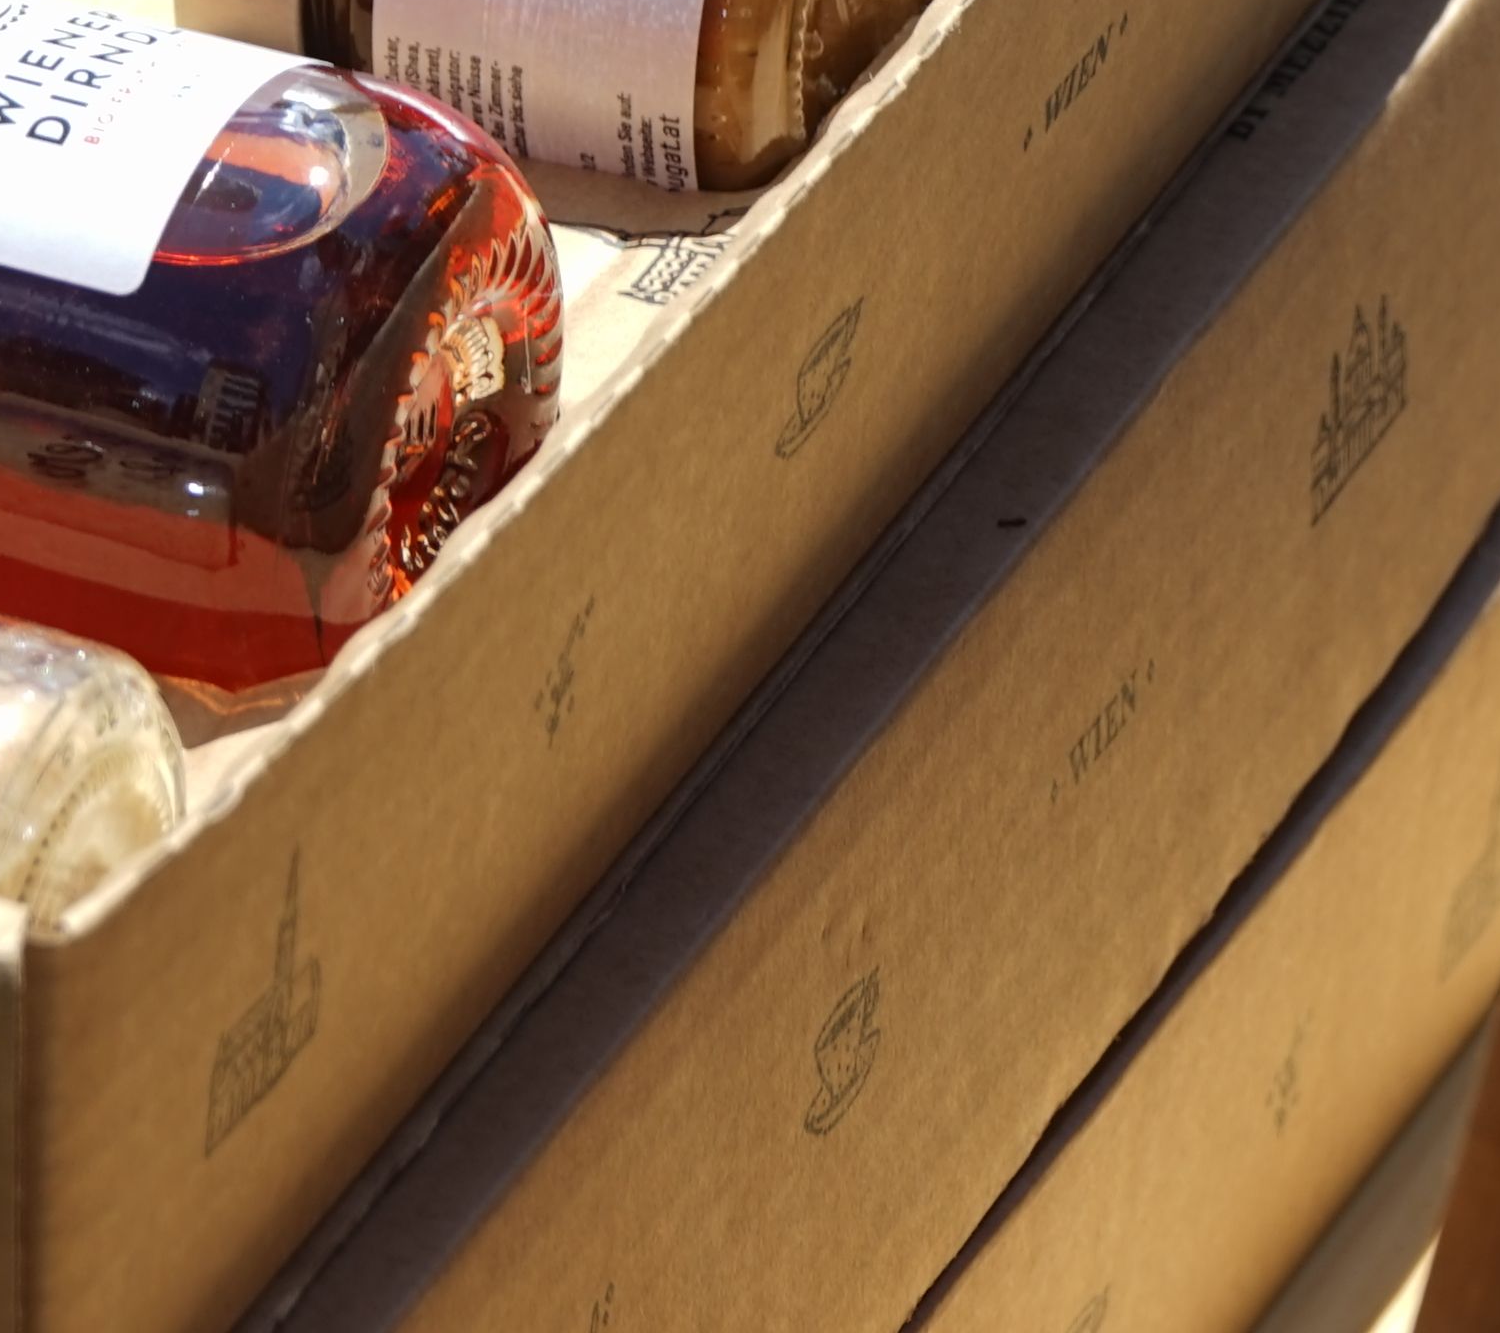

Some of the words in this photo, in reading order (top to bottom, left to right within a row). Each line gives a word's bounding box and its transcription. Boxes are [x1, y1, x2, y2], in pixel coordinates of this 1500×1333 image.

[1045, 22, 1114, 134] WIEN
[659, 112, 689, 192] ugat.at
[1068, 669, 1138, 786] WIEN
